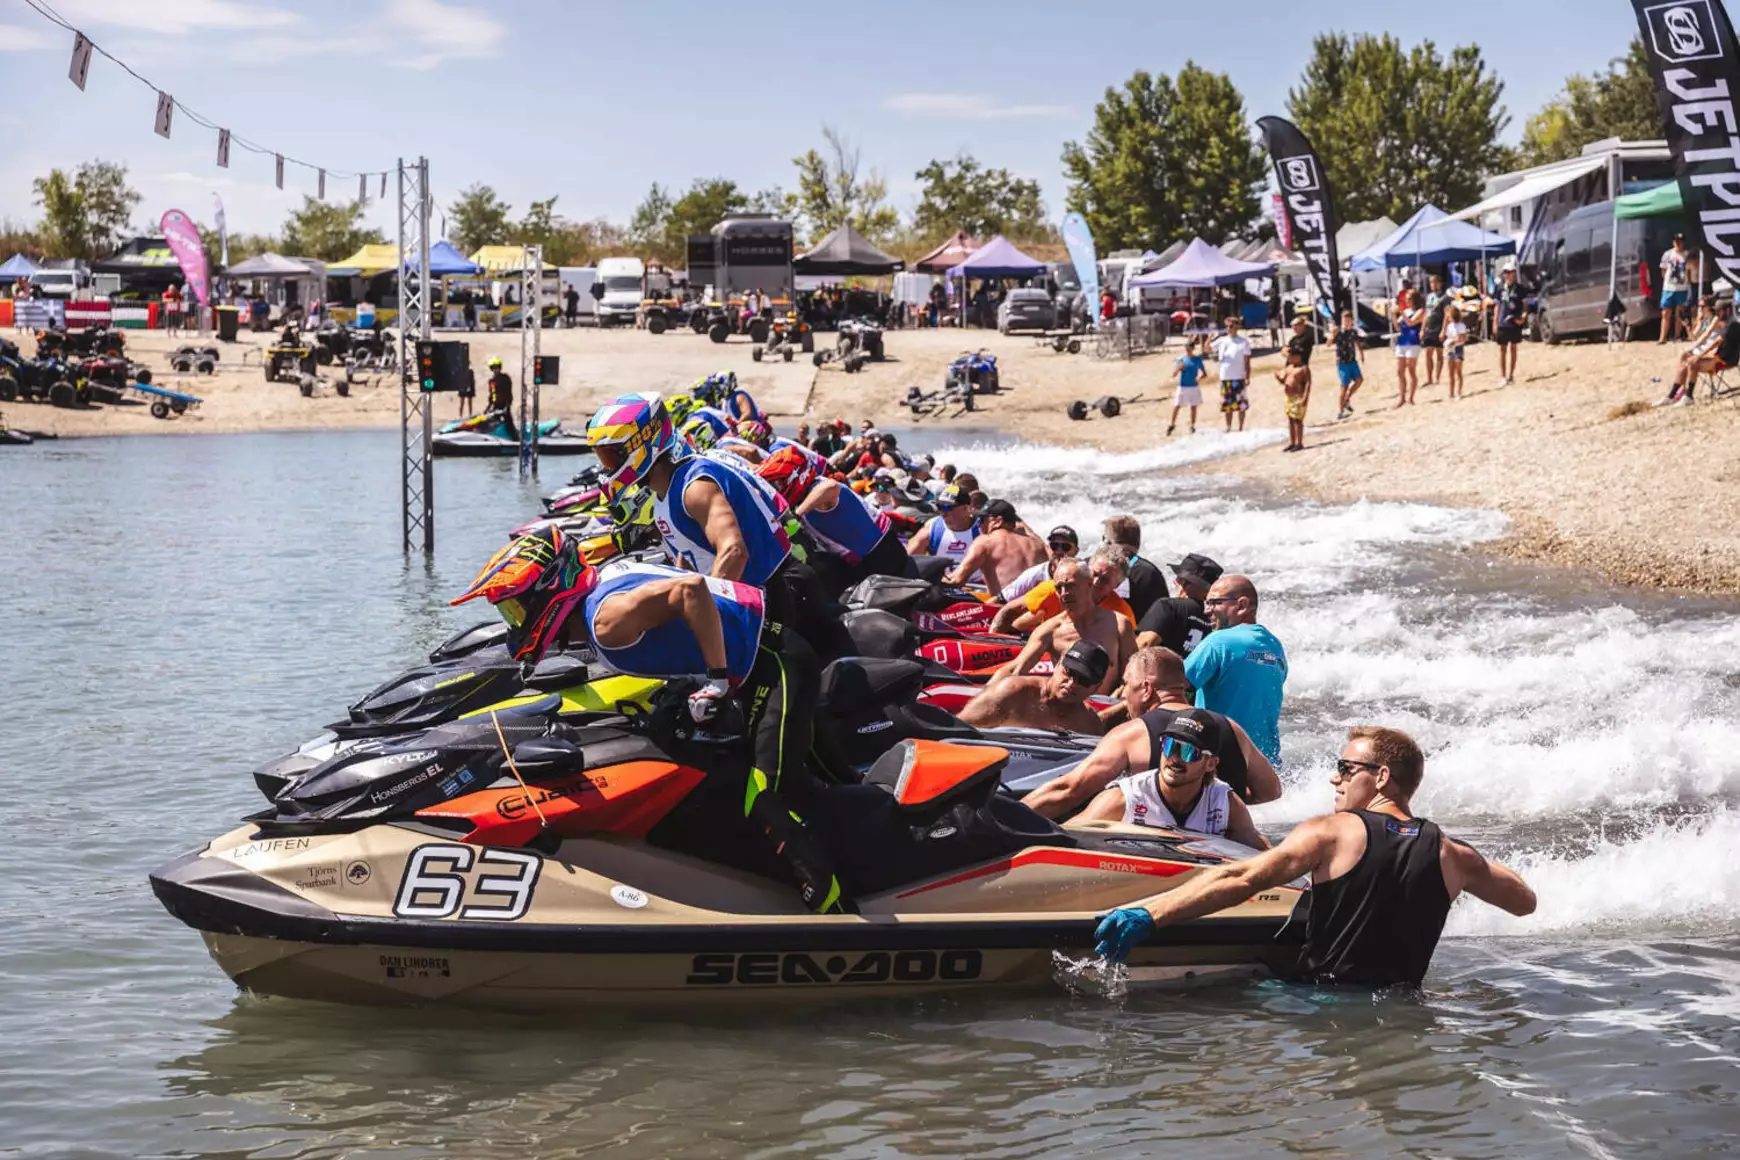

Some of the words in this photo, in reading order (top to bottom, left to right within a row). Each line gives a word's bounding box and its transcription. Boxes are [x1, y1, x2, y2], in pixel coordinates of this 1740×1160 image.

[426, 763, 445, 778] EL
[233, 838, 310, 858] LAUFEN
[1099, 861, 1137, 873] ROTAX
[296, 878, 336, 891] Sparbank
[392, 841, 544, 921] 63
